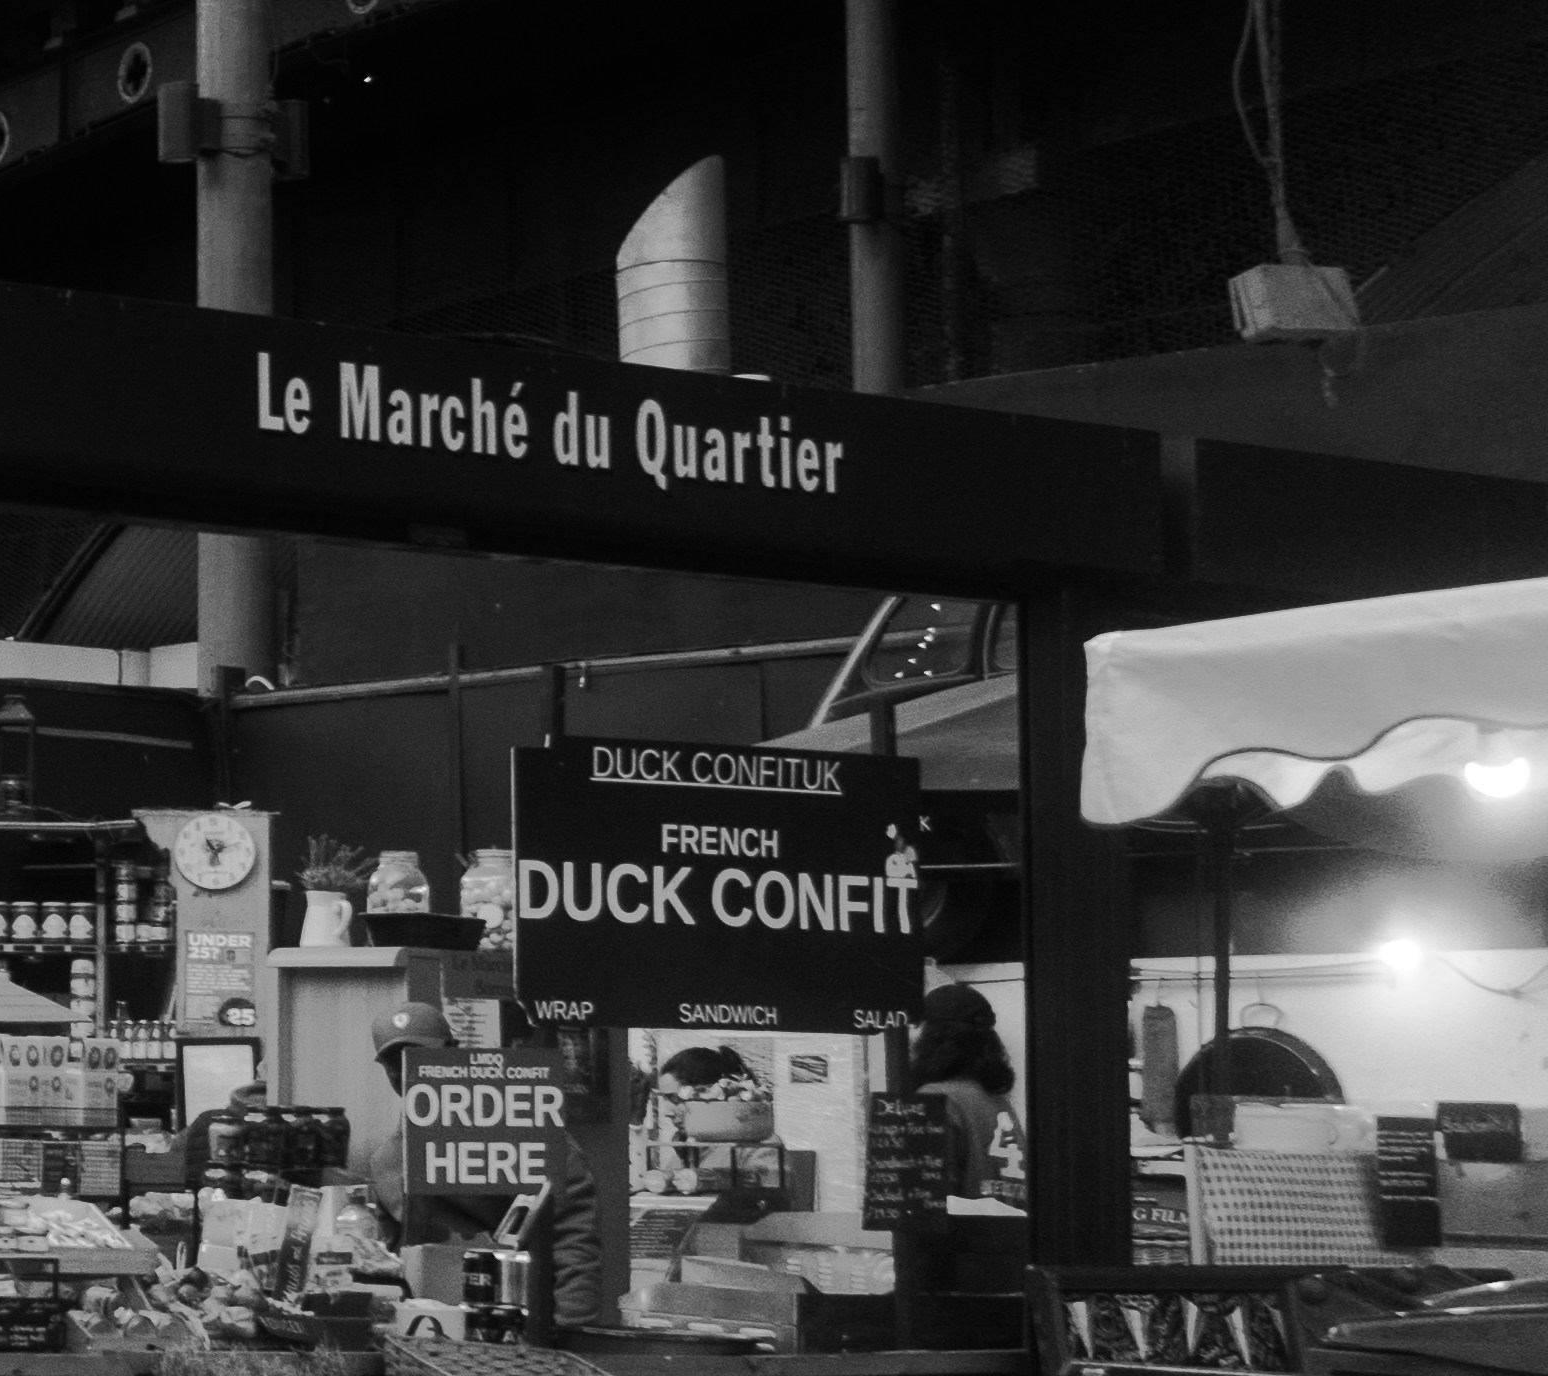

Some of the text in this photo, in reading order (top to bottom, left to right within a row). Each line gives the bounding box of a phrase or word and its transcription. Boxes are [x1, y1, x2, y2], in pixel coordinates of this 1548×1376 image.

[257, 351, 843, 493] Le Marché du Quartier
[592, 745, 842, 792] DUCK CONFITUK
[661, 824, 779, 858] FRENCH
[518, 859, 918, 934] DUCK CONFIT
[188, 933, 252, 947] UNDER
[188, 946, 219, 960] 25?
[227, 1007, 255, 1025] 25
[535, 1000, 595, 1021] WRAP
[679, 1003, 778, 1025] SANDWICH
[854, 1010, 908, 1029] SALAD
[418, 1065, 550, 1079] FRENCH DUCK CONFIT
[406, 1083, 564, 1127] ORDER
[426, 1141, 547, 1184] HERE
